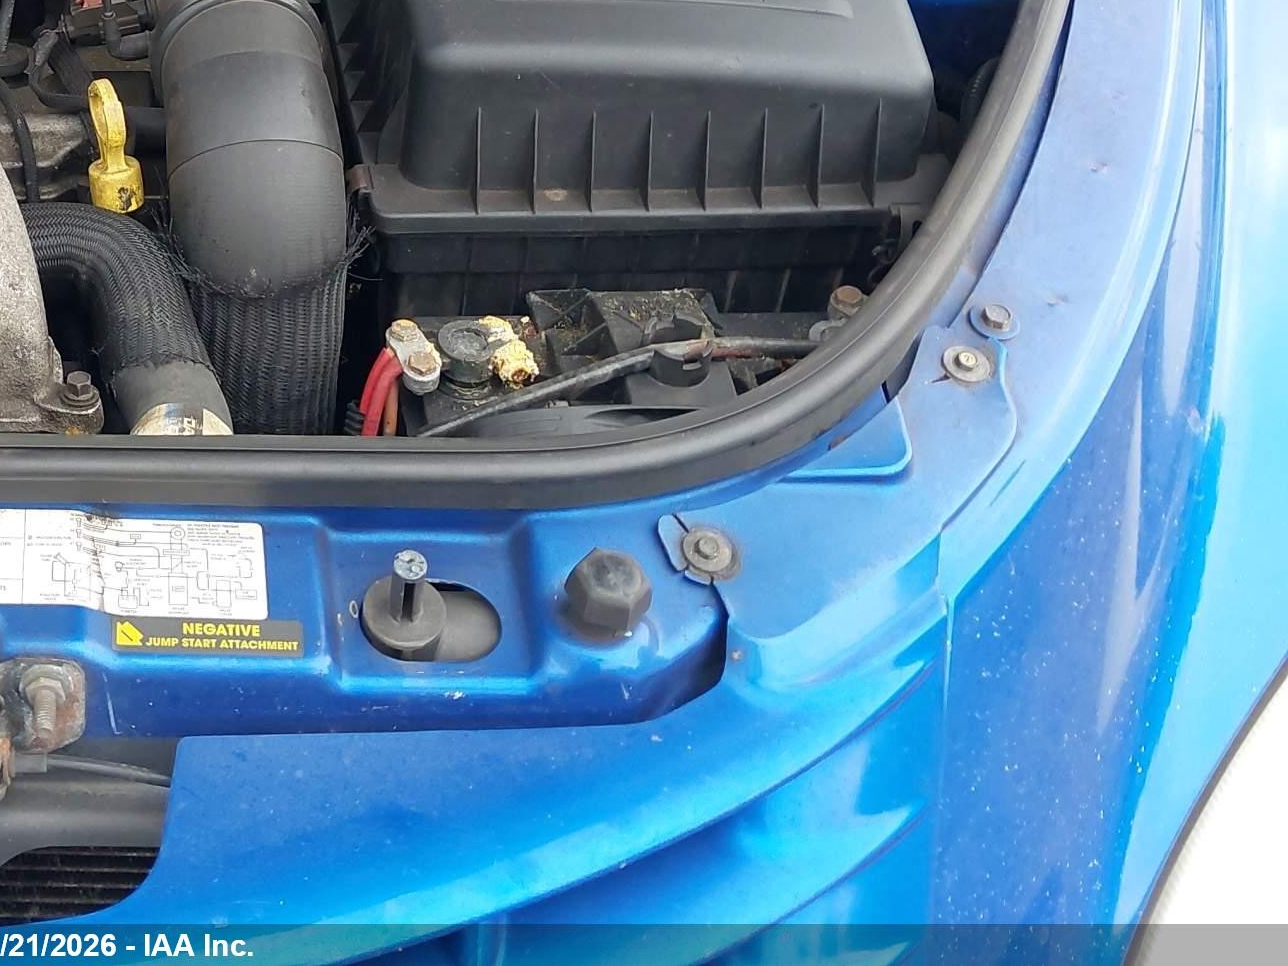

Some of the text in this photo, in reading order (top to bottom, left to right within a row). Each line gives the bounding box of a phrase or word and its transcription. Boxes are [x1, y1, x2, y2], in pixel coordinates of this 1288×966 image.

[182, 622, 261, 637] NEGATIVE
[145, 637, 299, 651] JUMP START ATTACHMENT
